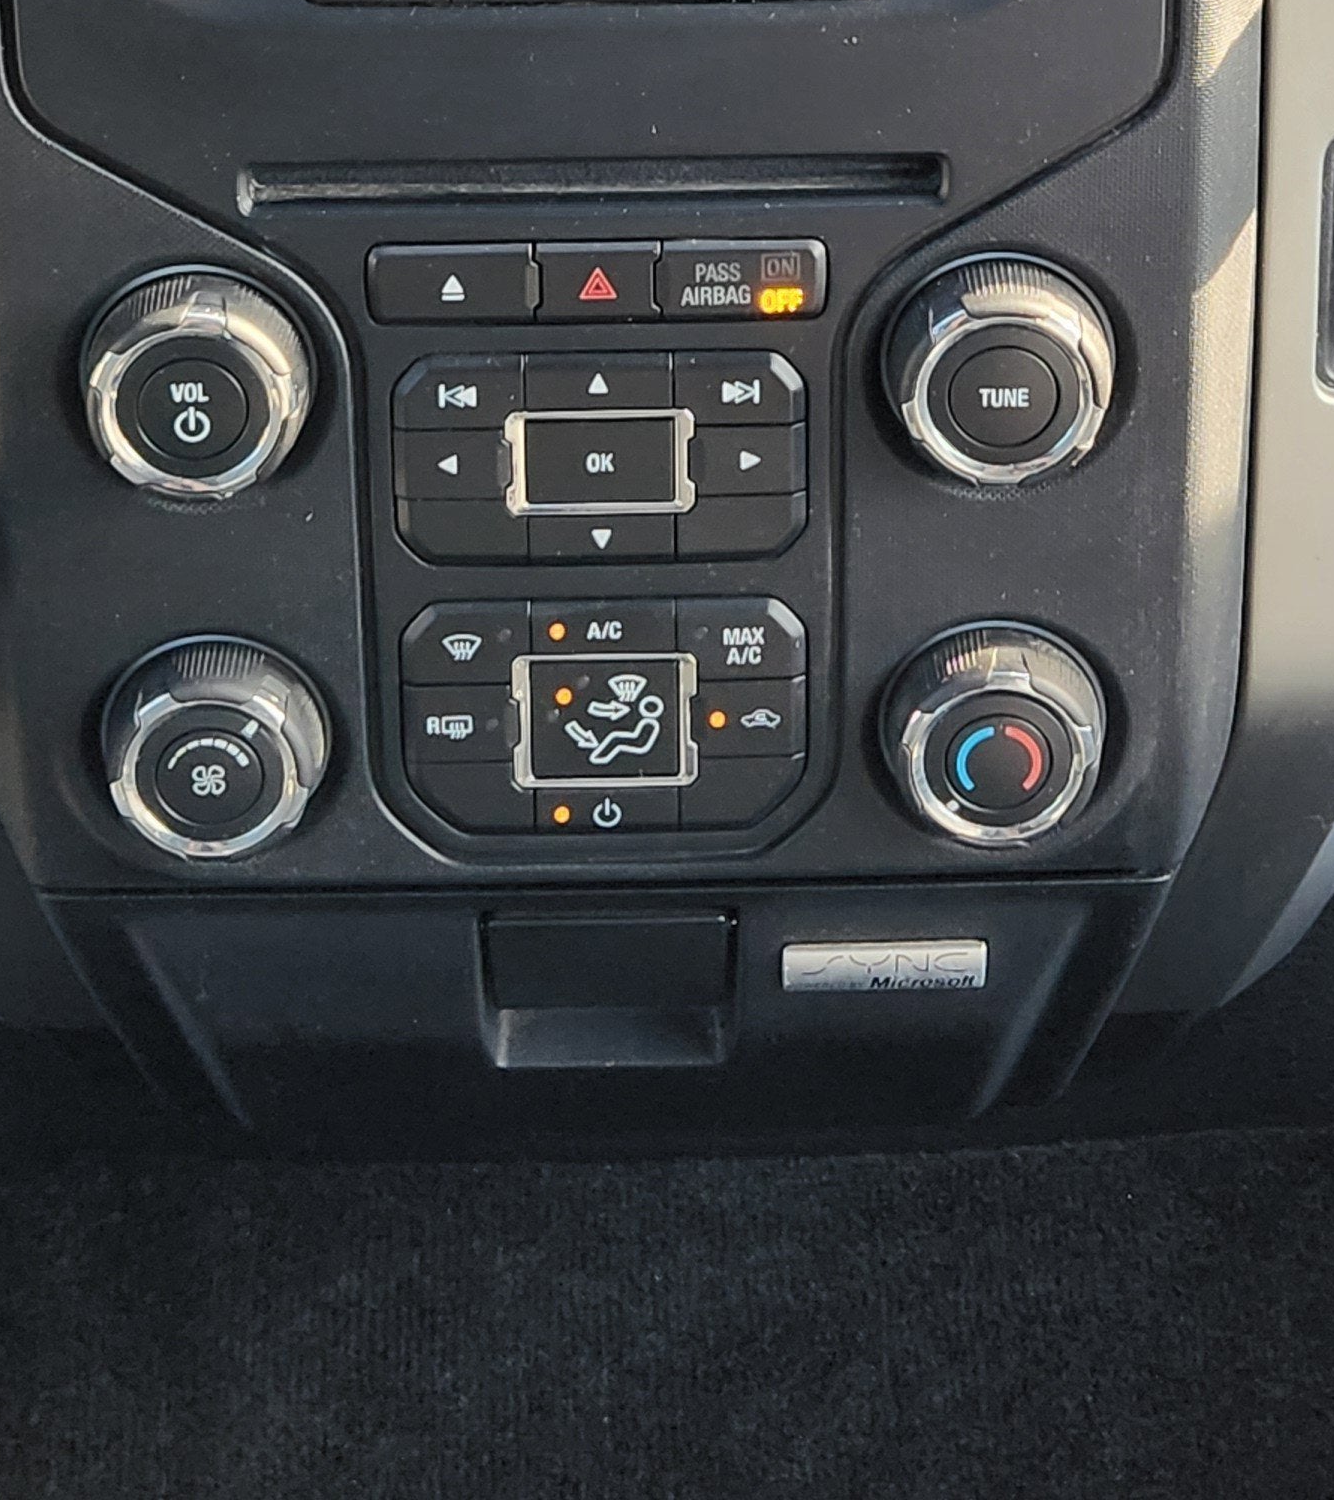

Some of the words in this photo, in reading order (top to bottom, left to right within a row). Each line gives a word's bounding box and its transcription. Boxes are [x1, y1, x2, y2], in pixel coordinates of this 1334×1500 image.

[695, 262, 741, 283] PASS
[766, 256, 795, 277] ON
[681, 284, 751, 307] AIRBAG
[760, 288, 804, 313] OFF
[170, 383, 209, 403] VOL
[979, 387, 1030, 408] TUNE
[586, 452, 615, 474] OK
[587, 622, 622, 640] A/C
[723, 627, 764, 646] MAX
[727, 646, 761, 665] A/C
[802, 952, 968, 975] SYNC
[870, 975, 976, 989] Microsoft
